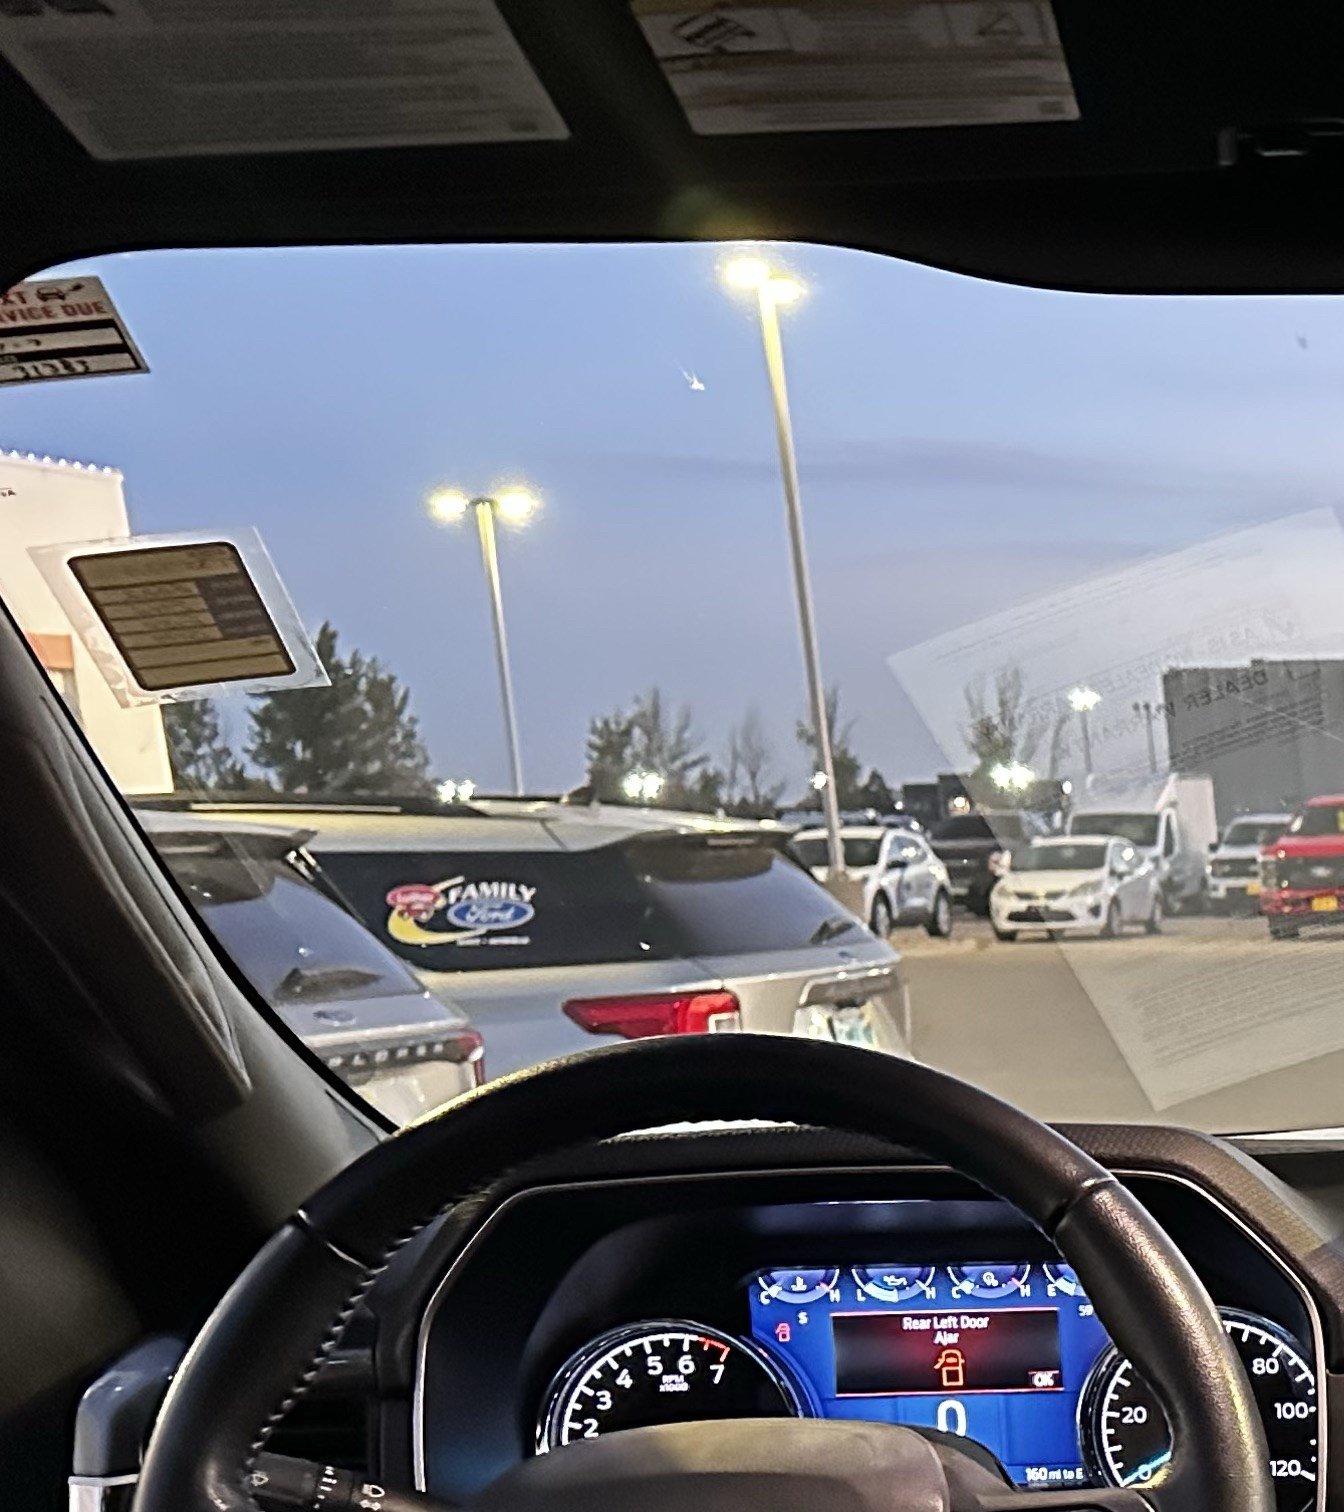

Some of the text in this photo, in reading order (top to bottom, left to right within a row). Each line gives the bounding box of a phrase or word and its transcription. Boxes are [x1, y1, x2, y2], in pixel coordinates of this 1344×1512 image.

[60, 301, 108, 317] DUE
[448, 881, 537, 905] FAMILY
[760, 1292, 770, 1304] C
[830, 1290, 840, 1302] H
[857, 1290, 866, 1301] L
[926, 1287, 936, 1299] H
[1020, 1285, 1030, 1297] H
[1047, 1284, 1055, 1296] E
[903, 1315, 989, 1330] Rear Left Door
[934, 1331, 959, 1345] Ajar
[647, 1356, 663, 1375] 5
[678, 1355, 695, 1374] 6
[1252, 1358, 1279, 1375] 80
[616, 1368, 633, 1389] 4
[662, 1375, 684, 1383] RPM
[710, 1364, 725, 1384] 7
[1033, 1374, 1054, 1387] OK
[596, 1391, 612, 1410] 3
[937, 1399, 967, 1437] 0
[1121, 1406, 1147, 1424] 20
[1274, 1401, 1309, 1419] 100
[583, 1418, 599, 1438] 2
[1026, 1468, 1083, 1480] 160 mi to E
[1270, 1459, 1301, 1477] 120
